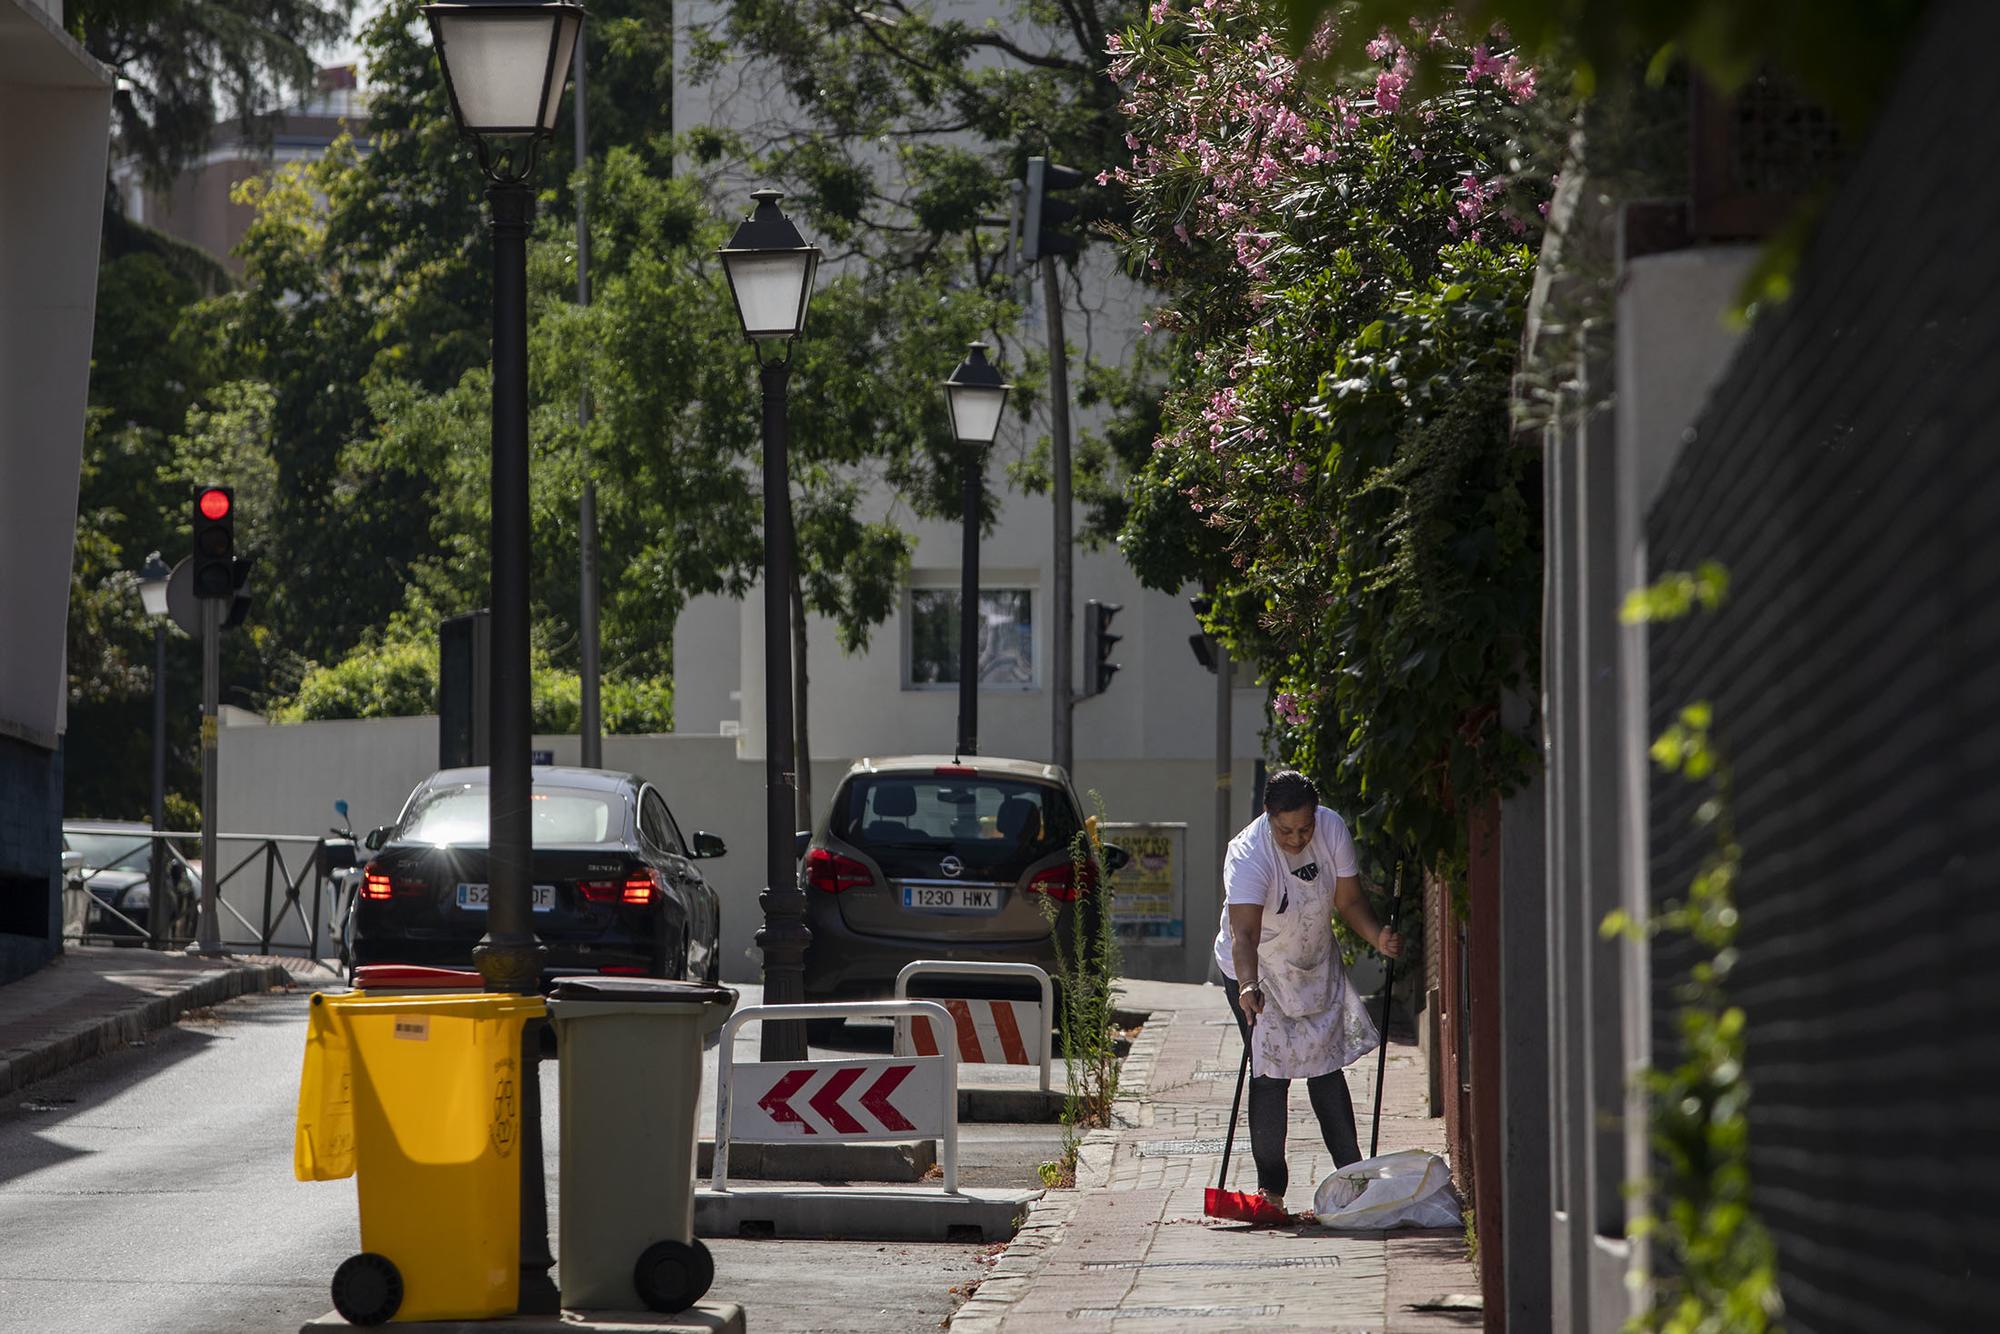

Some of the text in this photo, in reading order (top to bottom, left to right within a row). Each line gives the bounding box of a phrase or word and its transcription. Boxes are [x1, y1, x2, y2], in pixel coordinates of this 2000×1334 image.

[1112, 836, 1169, 846] COMPRO
[917, 889, 954, 906] 1230
[962, 890, 993, 907] HWX
